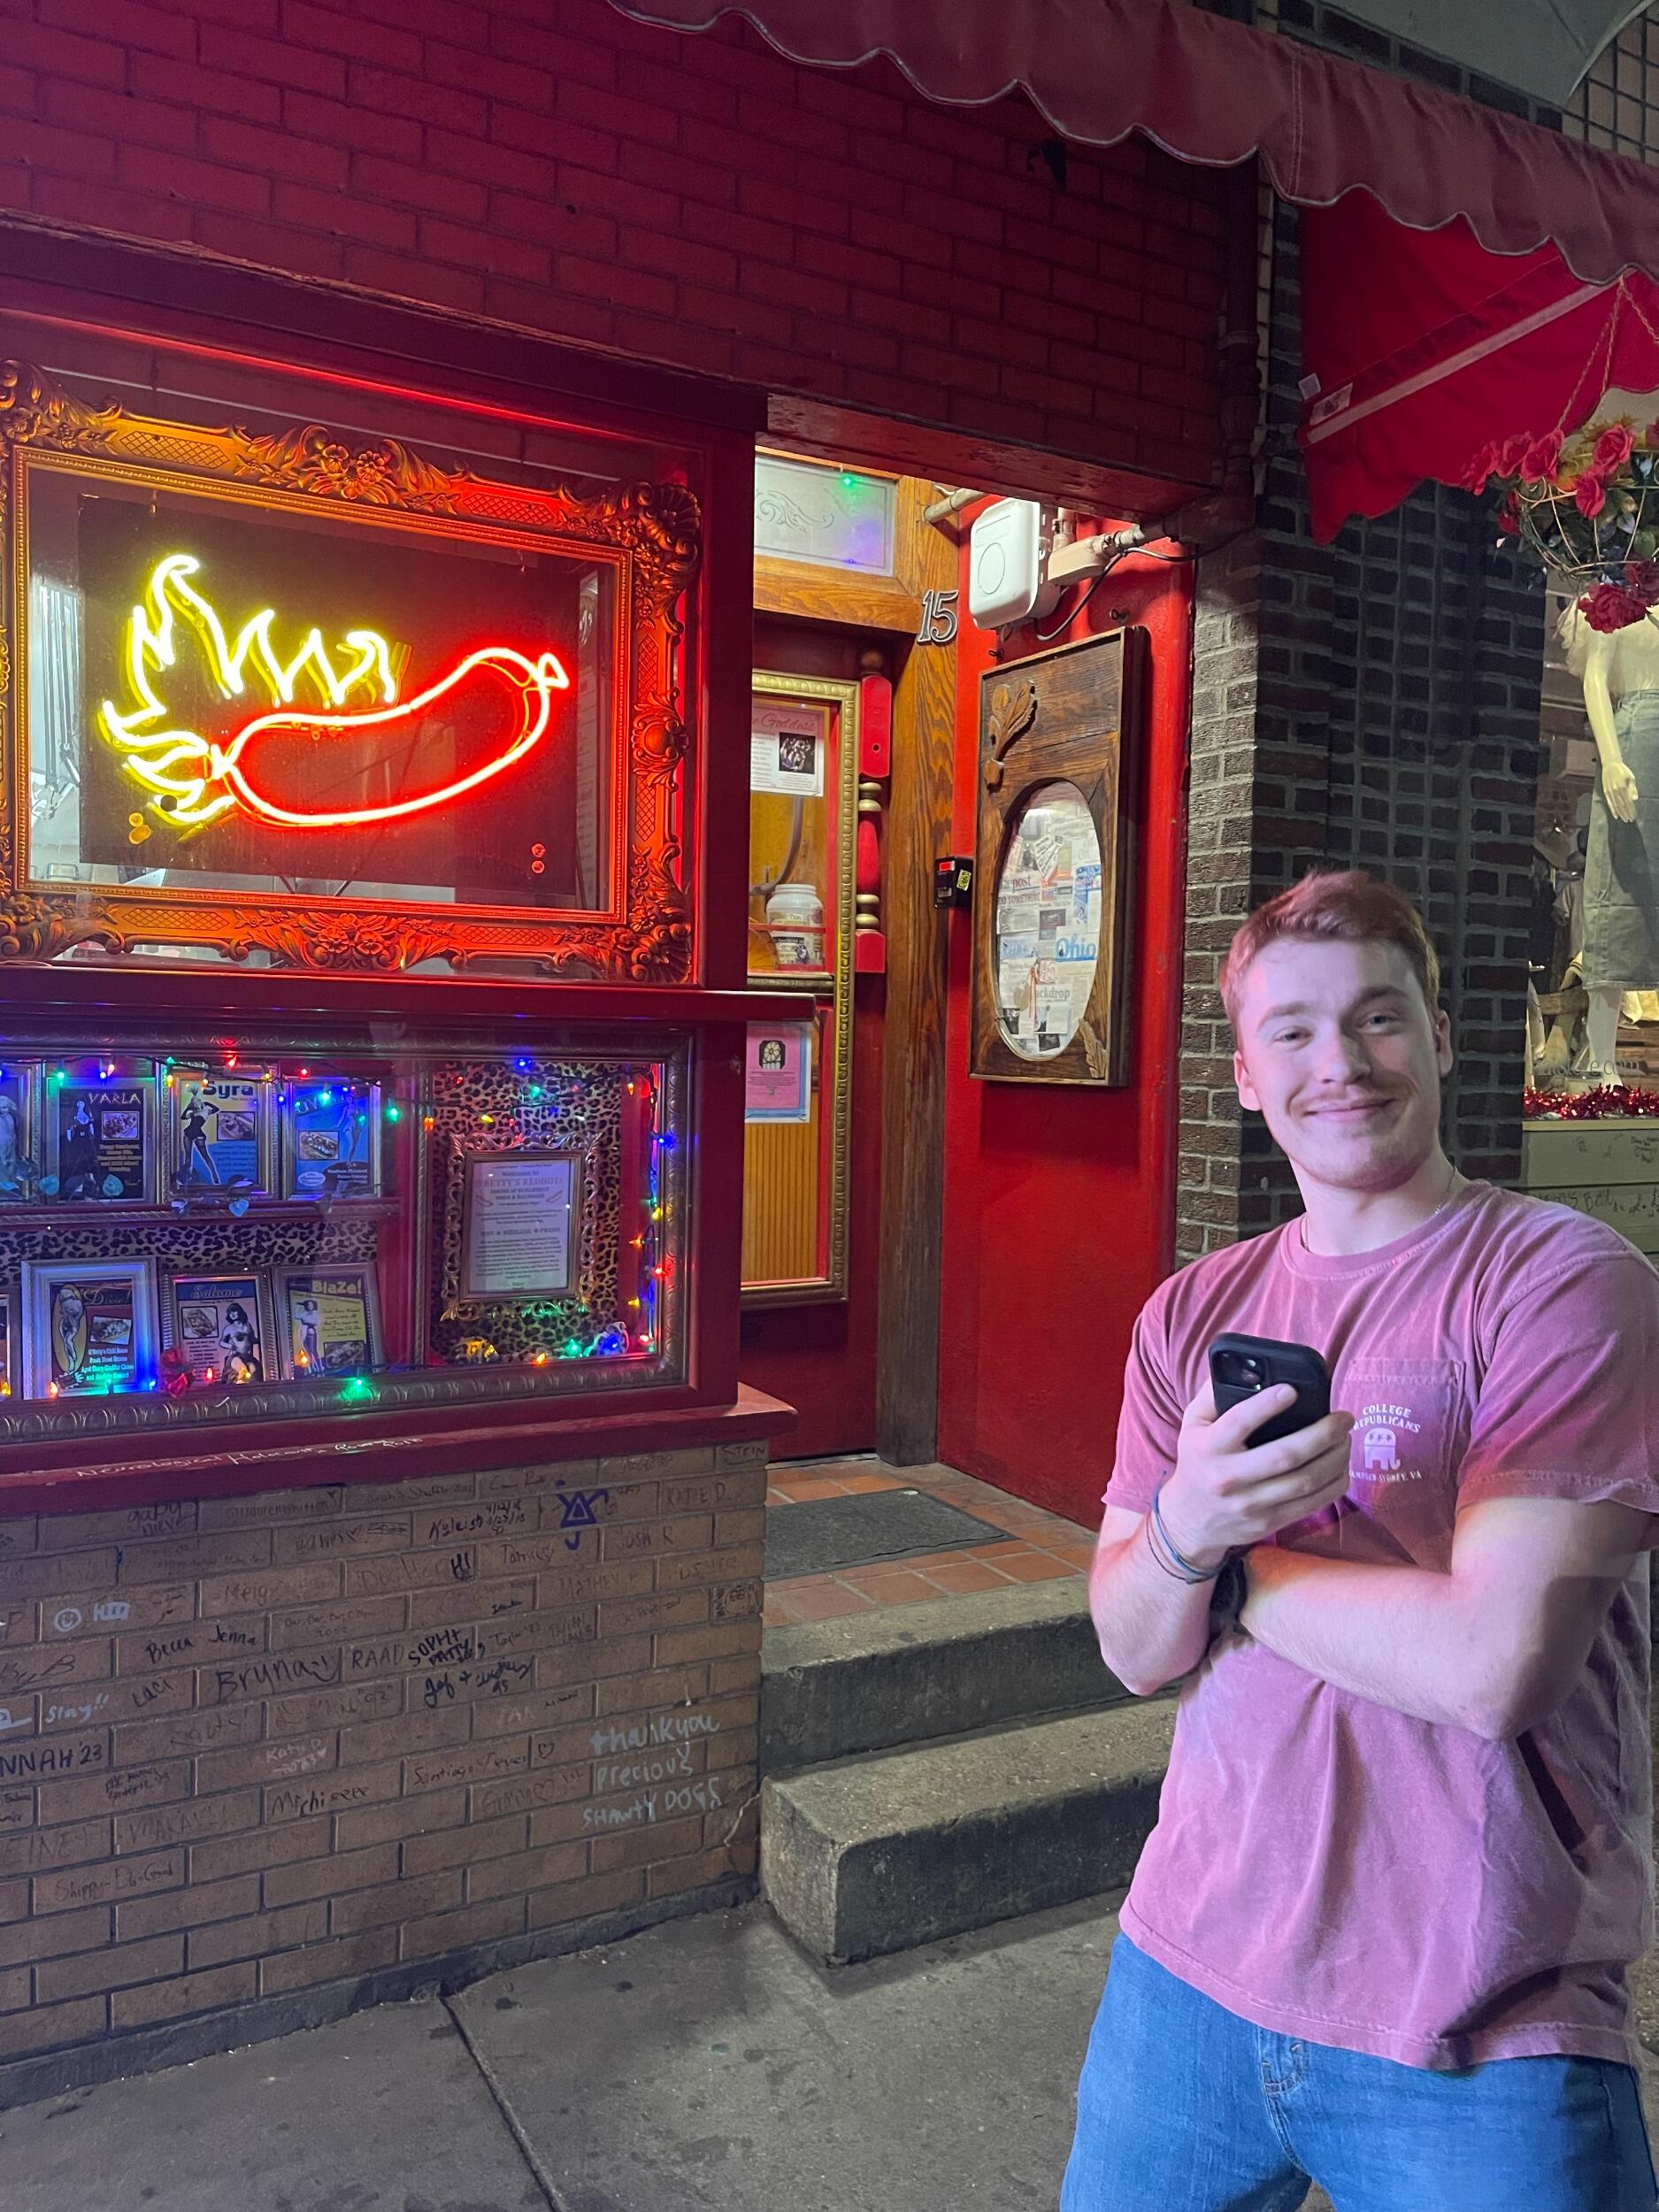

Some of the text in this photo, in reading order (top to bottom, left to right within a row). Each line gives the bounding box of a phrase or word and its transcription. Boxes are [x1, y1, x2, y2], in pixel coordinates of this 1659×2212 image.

[918, 589, 959, 645] 15
[1056, 934, 1097, 958] Ohio
[1034, 986, 1071, 1001] ackdrop
[88, 1092, 142, 1105] VARLA
[203, 1080, 255, 1100] Syra
[1363, 1403, 1412, 1418] COLLEGE
[1353, 1415, 1421, 1434] REPUBLICANS
[1409, 1470, 1423, 1480] VA
[208, 1624, 259, 1647] Jenna
